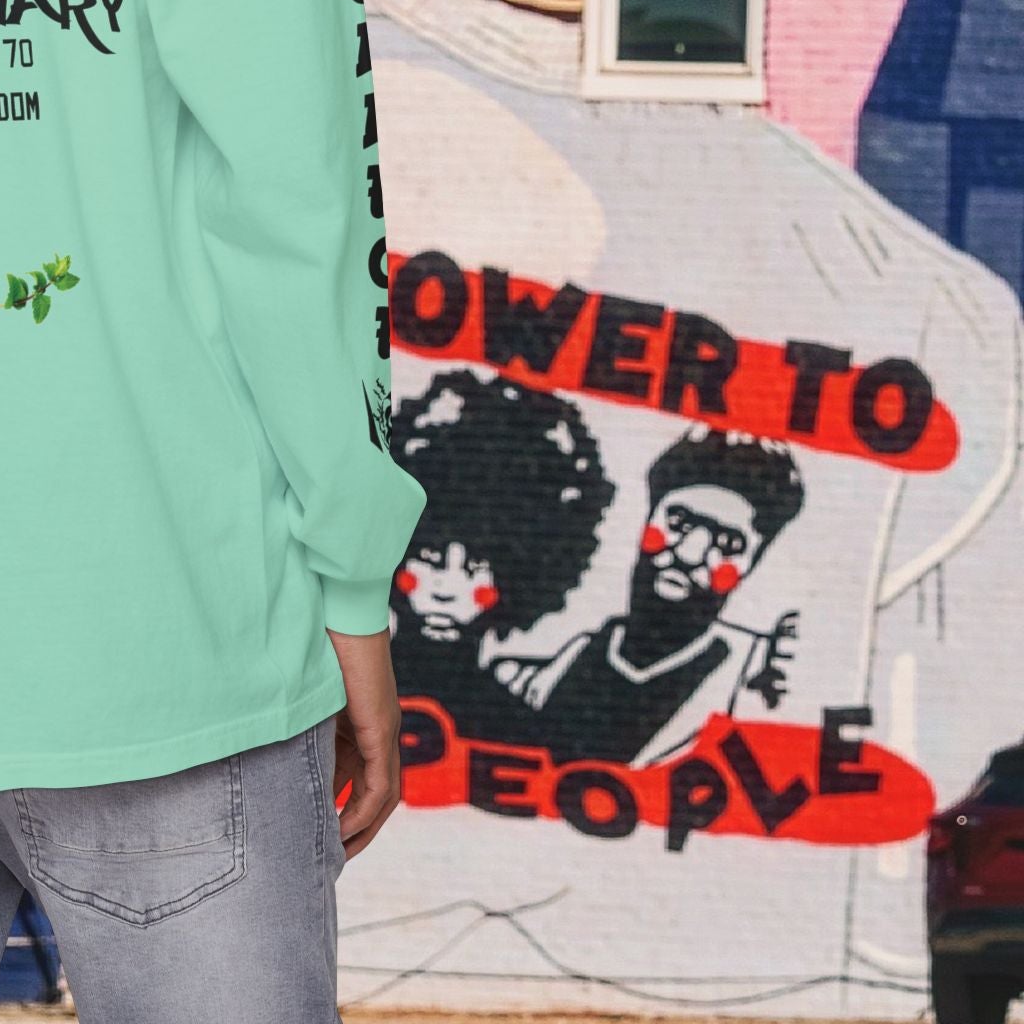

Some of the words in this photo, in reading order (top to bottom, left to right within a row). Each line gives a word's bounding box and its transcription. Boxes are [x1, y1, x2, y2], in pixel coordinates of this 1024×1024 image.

[3, 39, 33, 67] 70
[392, 250, 738, 416] OWER
[784, 338, 933, 456] TO
